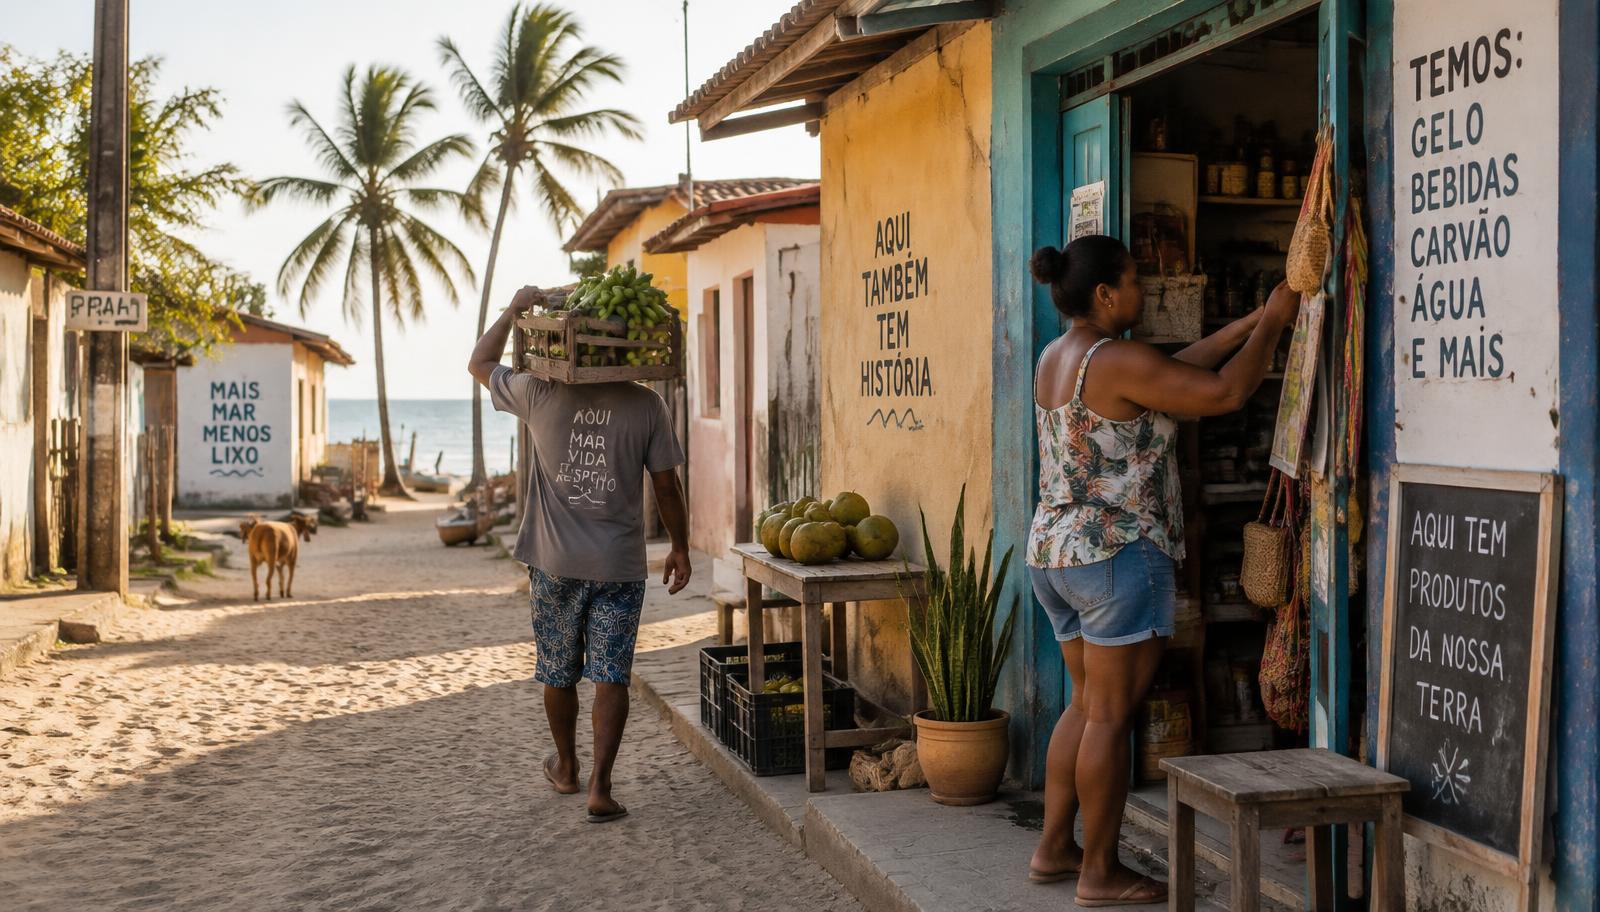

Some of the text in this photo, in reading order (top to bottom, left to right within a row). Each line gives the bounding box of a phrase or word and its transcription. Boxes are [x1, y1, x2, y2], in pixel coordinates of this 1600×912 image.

[1409, 28, 1523, 101] TEMOS:
[1411, 102, 1483, 158] GELO
[1411, 153, 1519, 214] BEBIDAS
[874, 211, 911, 258] AQUI
[1410, 207, 1511, 267] CARVÃO
[861, 251, 928, 307] TAMBÉM
[1411, 273, 1486, 322] ÁGUA
[876, 310, 909, 350] TEM
[1412, 338, 1426, 378] E
[210, 381, 260, 400] MAIS
[212, 403, 256, 421] MAR
[203, 424, 271, 442] MENOS
[211, 446, 259, 464] LIXO
[569, 429, 606, 450] MAR
[567, 449, 607, 467] VIDA
[1410, 510, 1507, 557] AQUI TEM
[1409, 567, 1506, 621] PRODUTOS
[1409, 625, 1504, 681] DA NOSSA
[1416, 681, 1482, 734] TERRA
